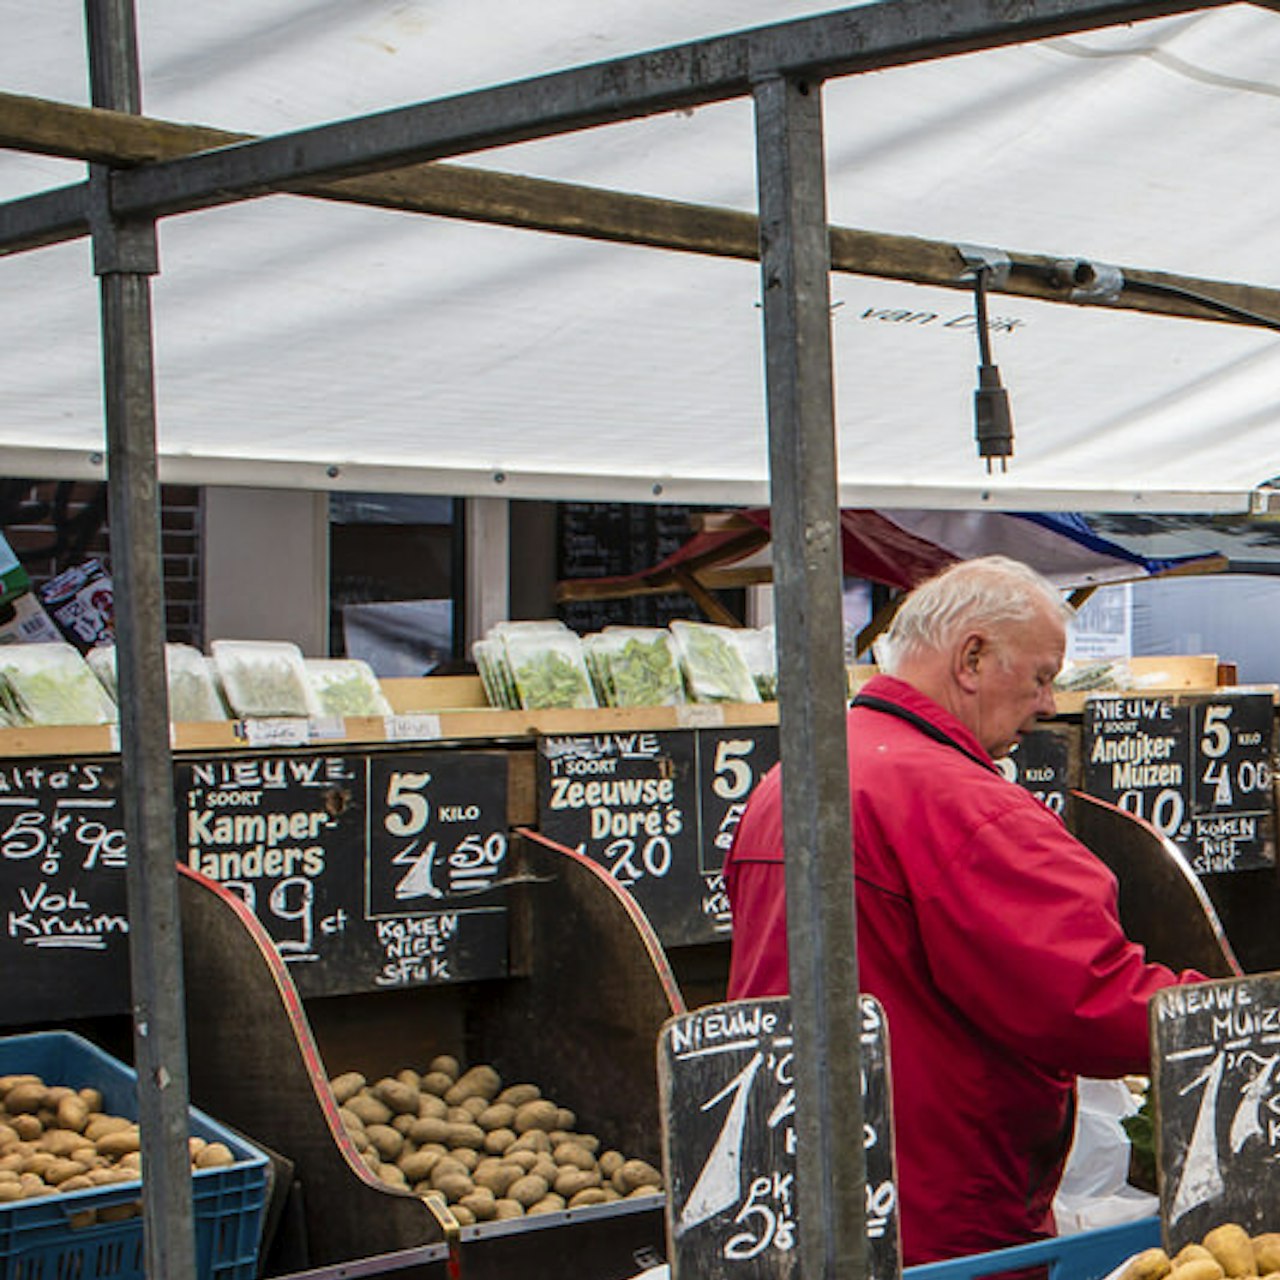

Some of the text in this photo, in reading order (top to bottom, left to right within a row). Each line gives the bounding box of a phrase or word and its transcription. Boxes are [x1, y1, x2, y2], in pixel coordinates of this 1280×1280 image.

[1201, 705, 1233, 758] 5
[711, 739, 756, 800] 5
[1112, 763, 1183, 791] Muizen
[206, 790, 263, 807] SOORT
[384, 771, 481, 837] 5 KILO
[549, 777, 674, 811] Zeeuwse
[187, 847, 326, 880] landers
